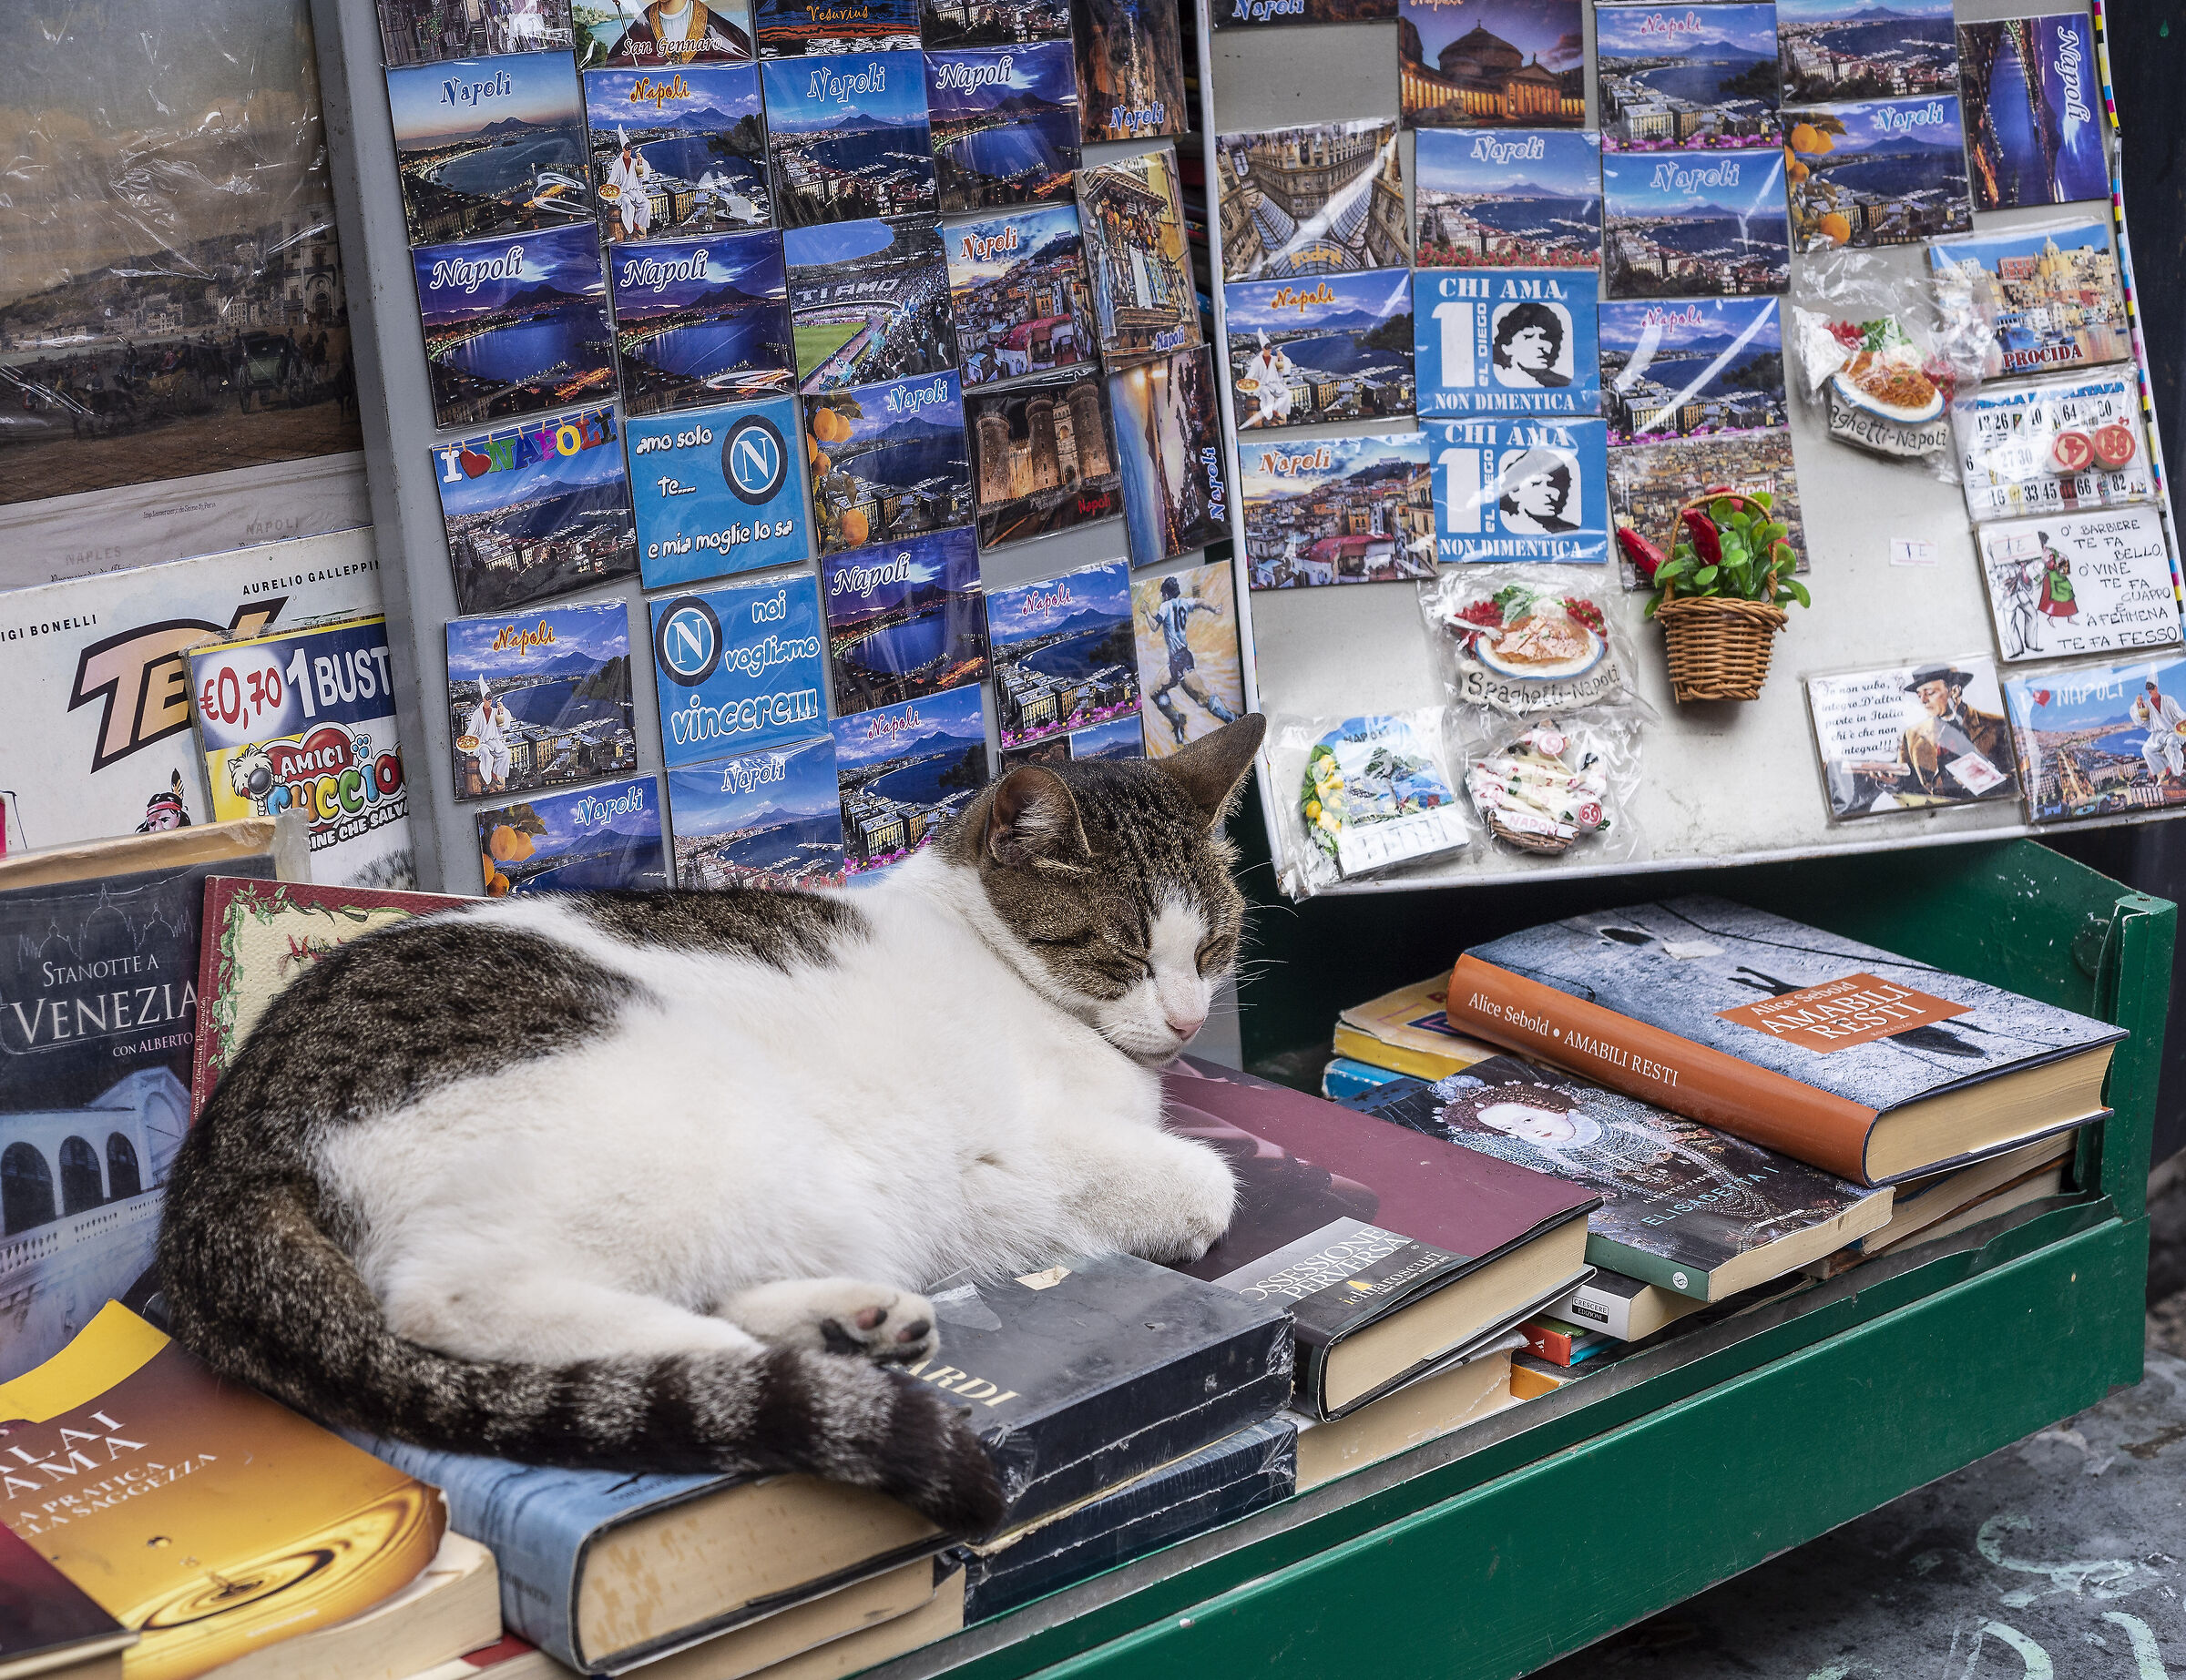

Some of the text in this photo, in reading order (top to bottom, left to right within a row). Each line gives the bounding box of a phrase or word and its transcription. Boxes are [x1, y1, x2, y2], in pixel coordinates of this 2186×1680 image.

[806, 5, 869, 23] Vesuvius
[1640, 12, 1702, 40] Napoli
[622, 36, 722, 57] San Gennaro
[441, 70, 512, 107] Napoli
[806, 63, 886, 103] Napoli
[935, 56, 1014, 95] Napoli
[2058, 26, 2092, 122] Napoli
[630, 74, 690, 108] Napoli
[1109, 101, 1164, 133] Napoli
[1875, 102, 1945, 132] Napoli
[1470, 136, 1546, 164] Napoli
[1651, 161, 1740, 193] Napoli
[960, 226, 1018, 261] Napoli
[429, 244, 525, 294] Napoli
[619, 249, 710, 293] Napoli
[834, 278, 901, 297] AMO
[1271, 282, 1336, 312] Napoli
[1438, 278, 1564, 300] CHI AMA
[1476, 302, 1488, 357] DIEGO
[1641, 305, 1704, 334] Napoli
[1155, 325, 1185, 351] Napoli
[2003, 342, 2084, 369] PROCIDA
[888, 379, 948, 412] Napoli
[1435, 392, 1576, 411] NON DIMENTICA
[2062, 403, 2078, 422] 64
[441, 412, 618, 484] I NAPOLI
[636, 424, 713, 454] amo solo
[1445, 424, 1571, 446] CHI AMA
[736, 436, 771, 484] N
[1259, 448, 1331, 477] Napoli
[1201, 447, 1226, 522] Napoli
[1731, 479, 1776, 496] apoli
[2024, 484, 2039, 502] 33
[2043, 482, 2058, 500] 45
[2077, 478, 2092, 495] 66
[2112, 473, 2127, 492] 82
[1078, 492, 1111, 516] Napoli
[247, 516, 300, 535] NAPOLI
[648, 519, 793, 559] e mia moglie lo sa
[2081, 519, 2140, 535] BARBIERE
[1439, 538, 1582, 557] NON DIMENTICA
[2073, 536, 2124, 549] TE FA
[2114, 543, 2163, 561] BELLO,
[242, 575, 302, 596] AURELIO
[832, 551, 912, 598] Napoli
[2100, 578, 2150, 590] TE FA
[751, 589, 787, 624] noi
[1022, 583, 1072, 616] Napoli
[2115, 603, 2126, 613] E
[2121, 587, 2171, 602] GUAPPO
[30, 614, 97, 636] BONELLI
[493, 620, 556, 657] Napoli
[672, 616, 706, 666] N
[724, 636, 821, 678] vogliamo
[2058, 636, 2085, 649] TE
[2089, 636, 2110, 647] FA
[199, 667, 284, 730] €0,70
[285, 647, 319, 718] 1
[2056, 677, 2123, 708] NAPOLI
[867, 706, 921, 741] Napoli
[1856, 714, 1866, 722] in
[1871, 709, 1904, 721] Italia
[1343, 728, 1391, 743] NAPO
[1858, 727, 1874, 738] che
[1878, 727, 1897, 736] non
[281, 744, 344, 778] AMICI
[721, 756, 786, 795] Napoli
[266, 743, 406, 822] CUCCIO
[575, 786, 644, 827] Napoli
[310, 831, 336, 850] INE
[339, 818, 367, 840] CHE
[42, 955, 144, 987] STANOTTE
[10, 980, 199, 1044] VENEZIA
[1750, 981, 1860, 1017] Alice Sebold
[1761, 983, 1915, 1034] AMABILI
[1804, 1001, 1927, 1040] RESTI
[138, 1032, 194, 1054] ALBERTO
[1468, 992, 1501, 1018] Alice
[1504, 1005, 1548, 1037] Sebold
[1563, 1029, 1629, 1068] AMABILI
[1630, 1054, 1680, 1087] RESTI
[1640, 1173, 1767, 1227] ELISABETTA
[1279, 1237, 1415, 1300] PERVERSA
[1573, 1297, 1608, 1315] CRESCERE
[1578, 1308, 1603, 1321] EDIZIONI
[42, 1462, 166, 1513] PRATICA
[72, 1453, 218, 1519] SAGGEZZA
